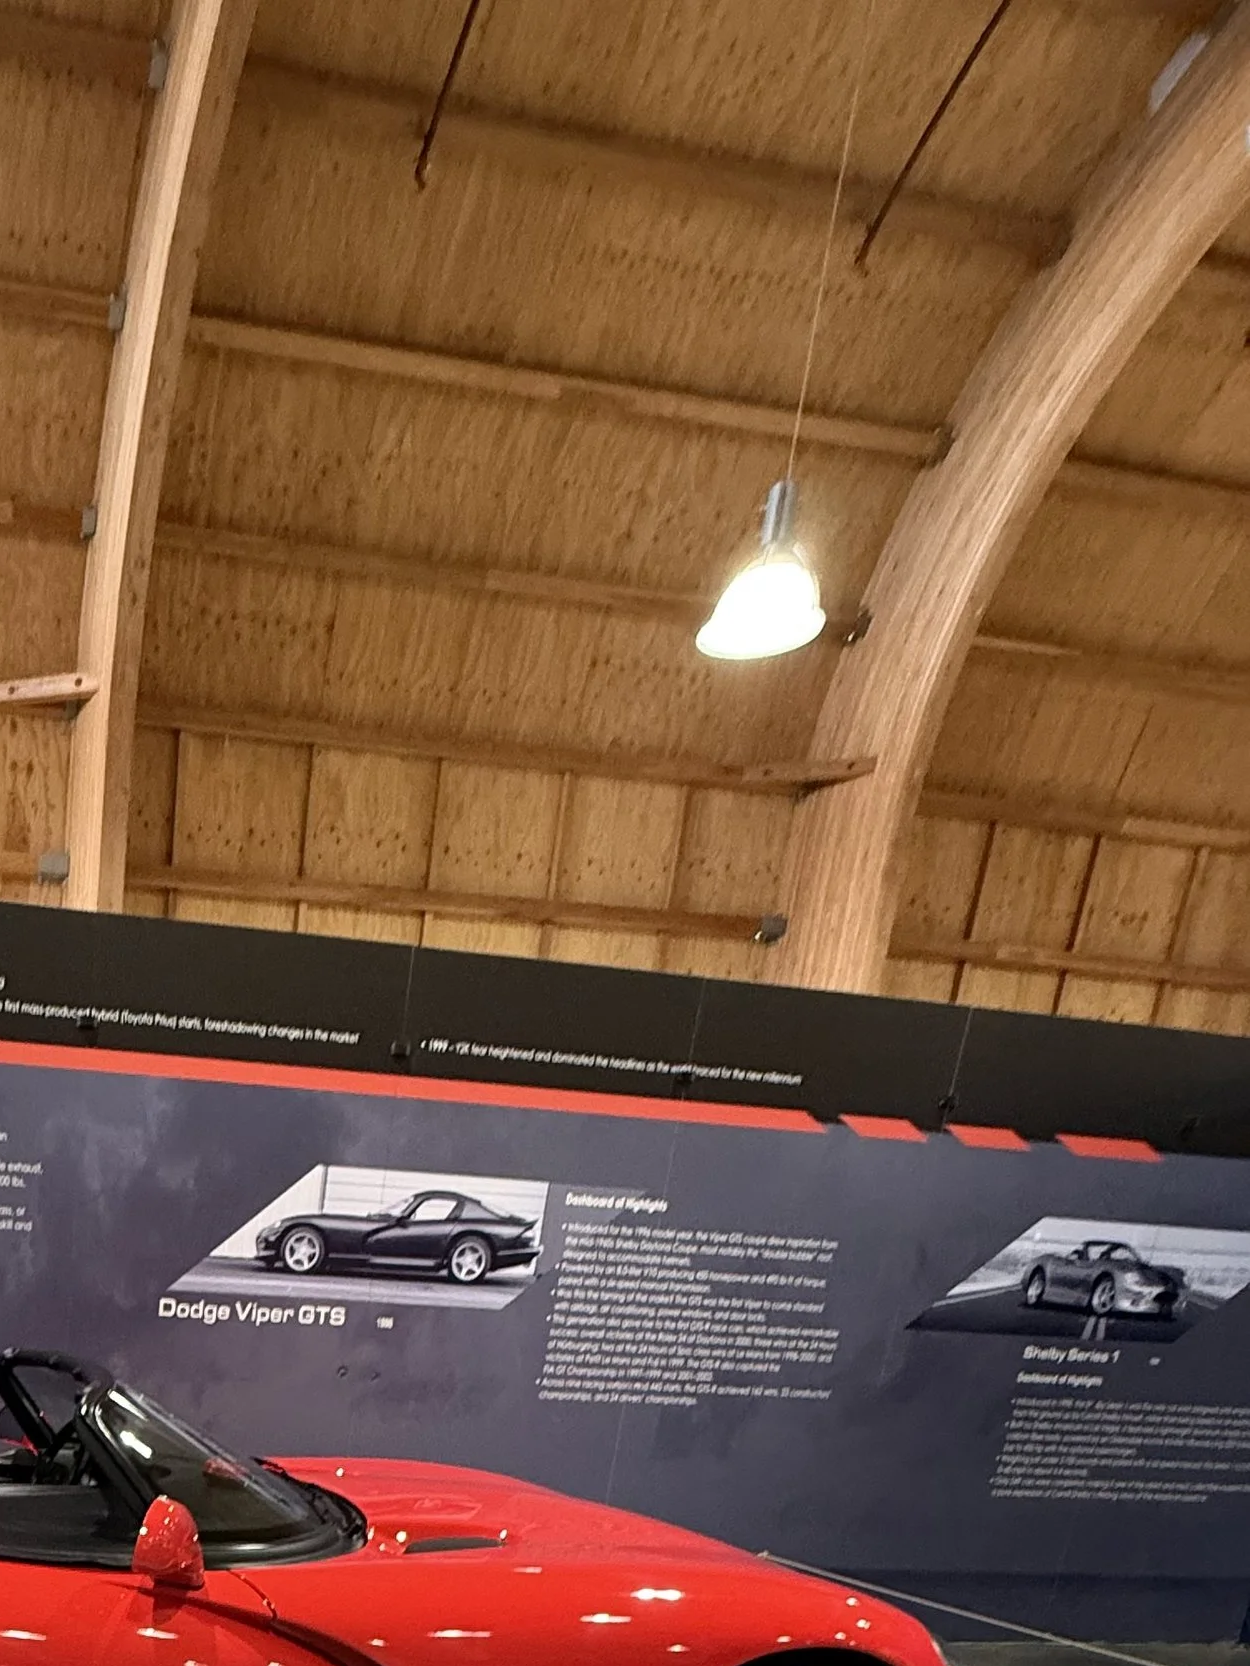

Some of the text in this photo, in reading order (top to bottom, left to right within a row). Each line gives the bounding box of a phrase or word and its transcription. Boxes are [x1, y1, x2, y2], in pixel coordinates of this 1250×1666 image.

[157, 1298, 345, 1325] Dodge Viper GTS
